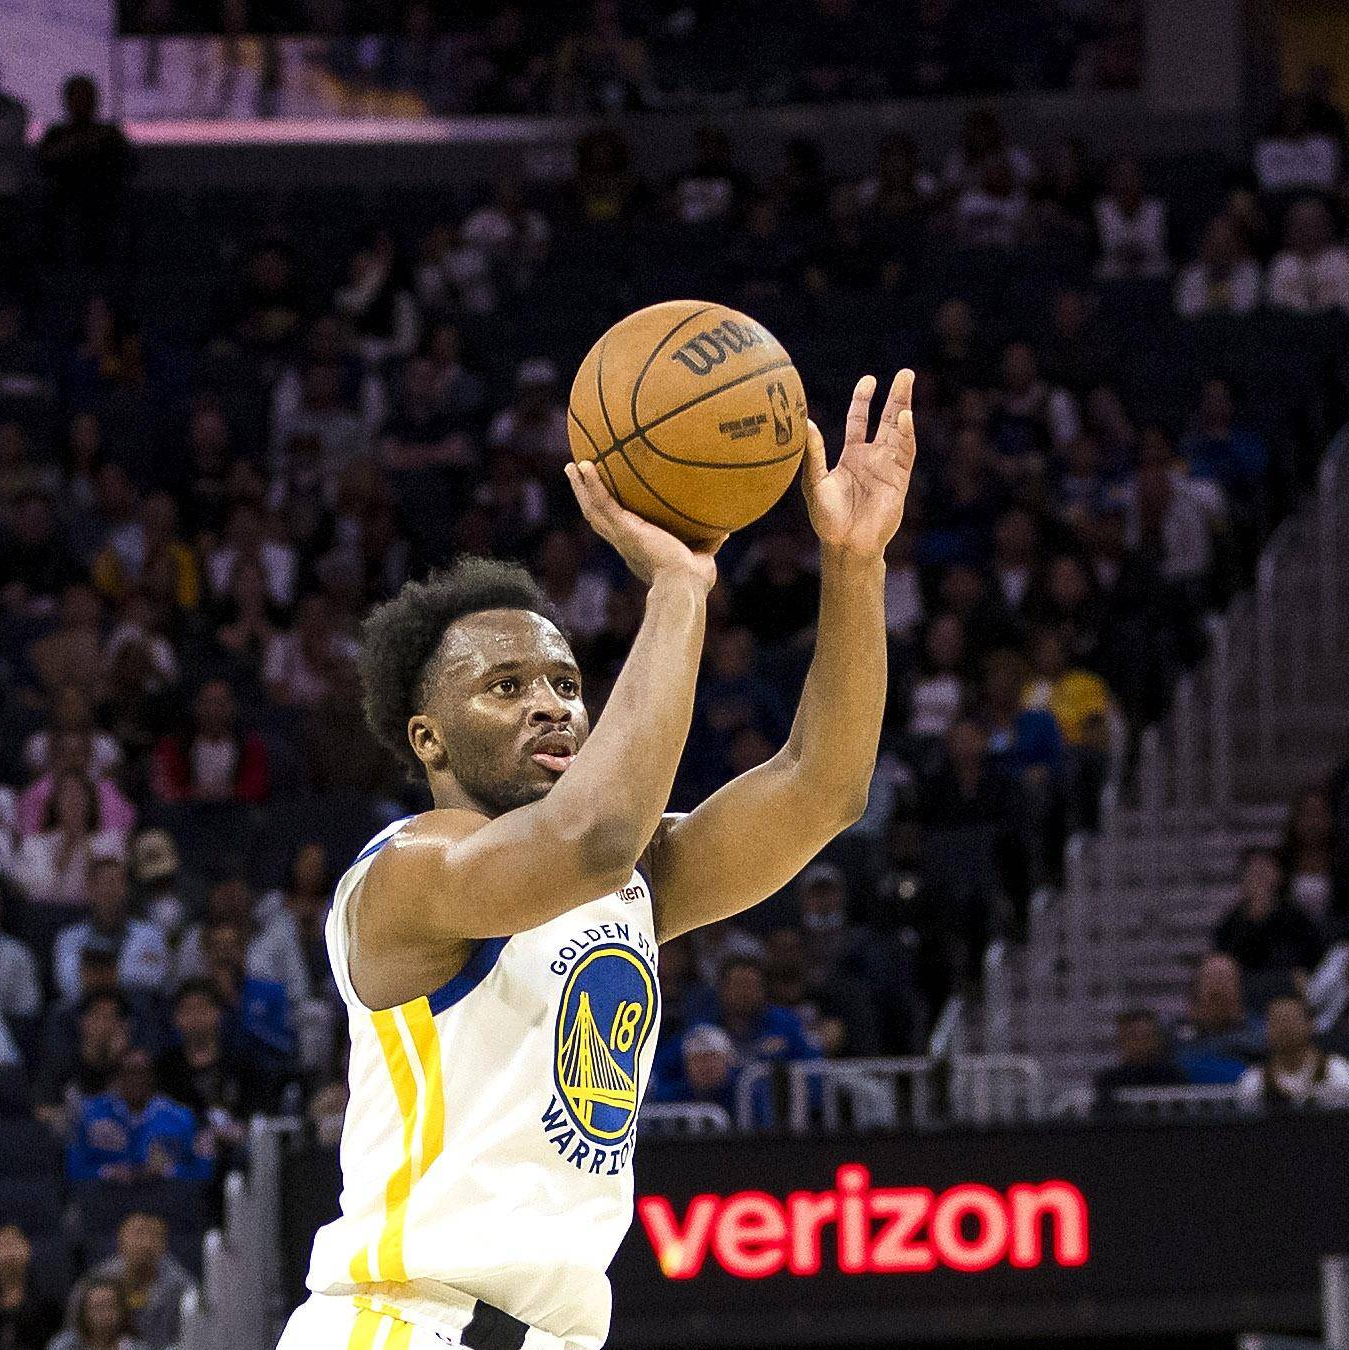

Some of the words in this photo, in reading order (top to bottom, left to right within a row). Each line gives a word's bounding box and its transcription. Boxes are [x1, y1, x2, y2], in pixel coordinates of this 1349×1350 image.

[550, 922, 630, 976] GOLDEN
[610, 1001, 642, 1053] 18
[637, 1163, 1088, 1279] verizon
